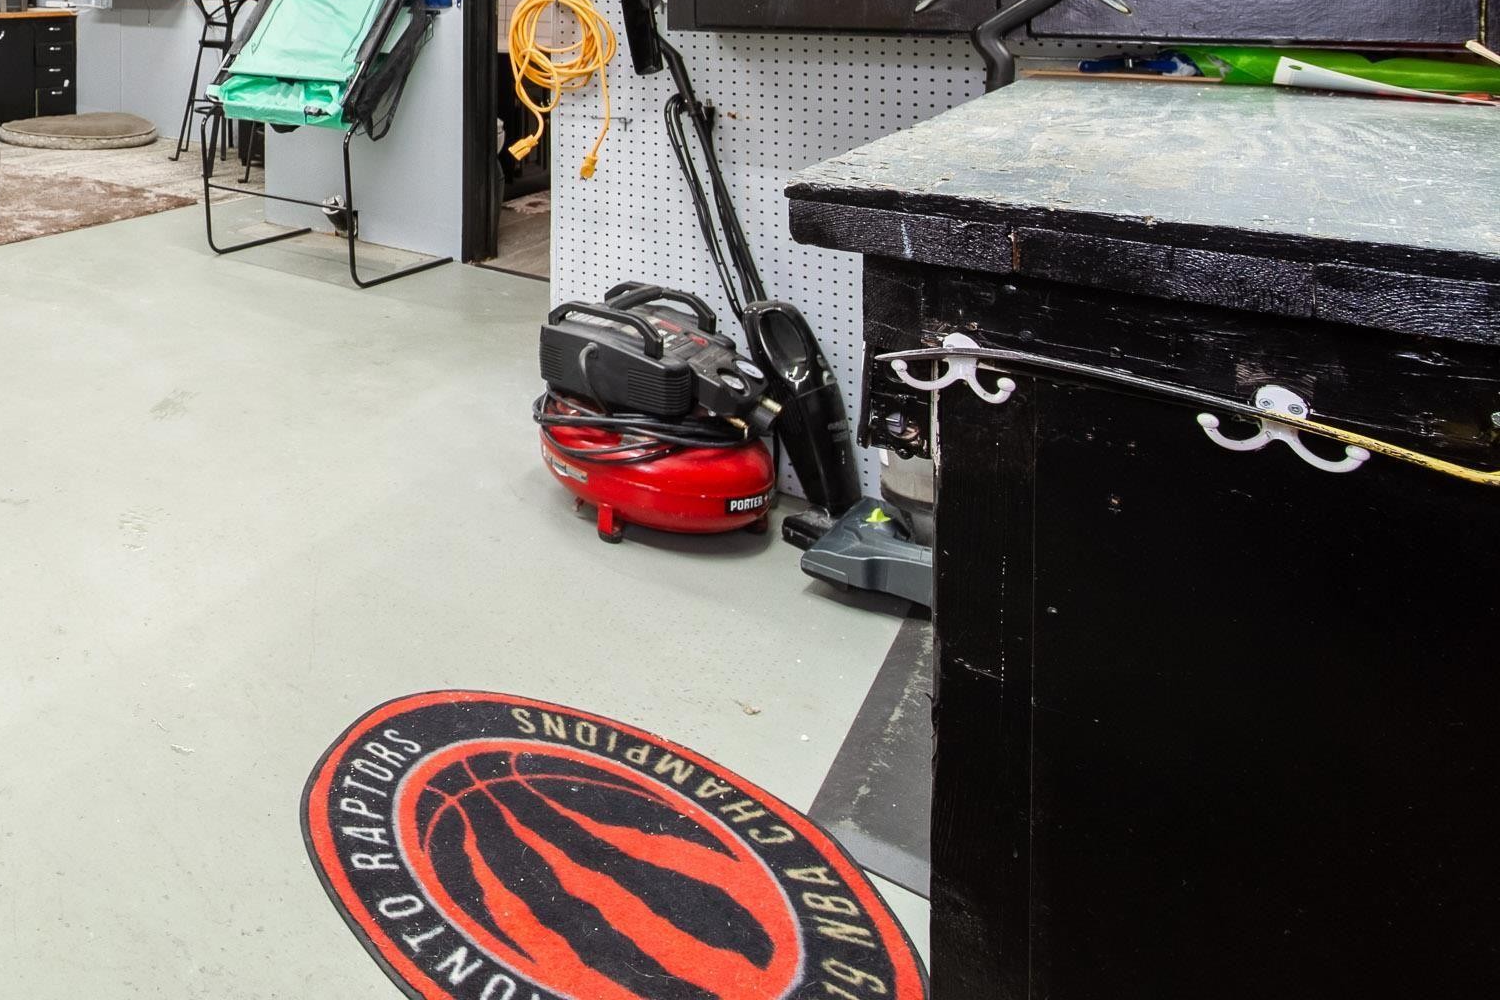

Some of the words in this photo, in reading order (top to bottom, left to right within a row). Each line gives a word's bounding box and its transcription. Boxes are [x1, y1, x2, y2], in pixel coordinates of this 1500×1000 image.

[730, 495, 763, 512] PORTER
[351, 726, 423, 872] RAPTORS
[510, 706, 797, 847] CHAMPIONS
[786, 865, 877, 949] NBA
